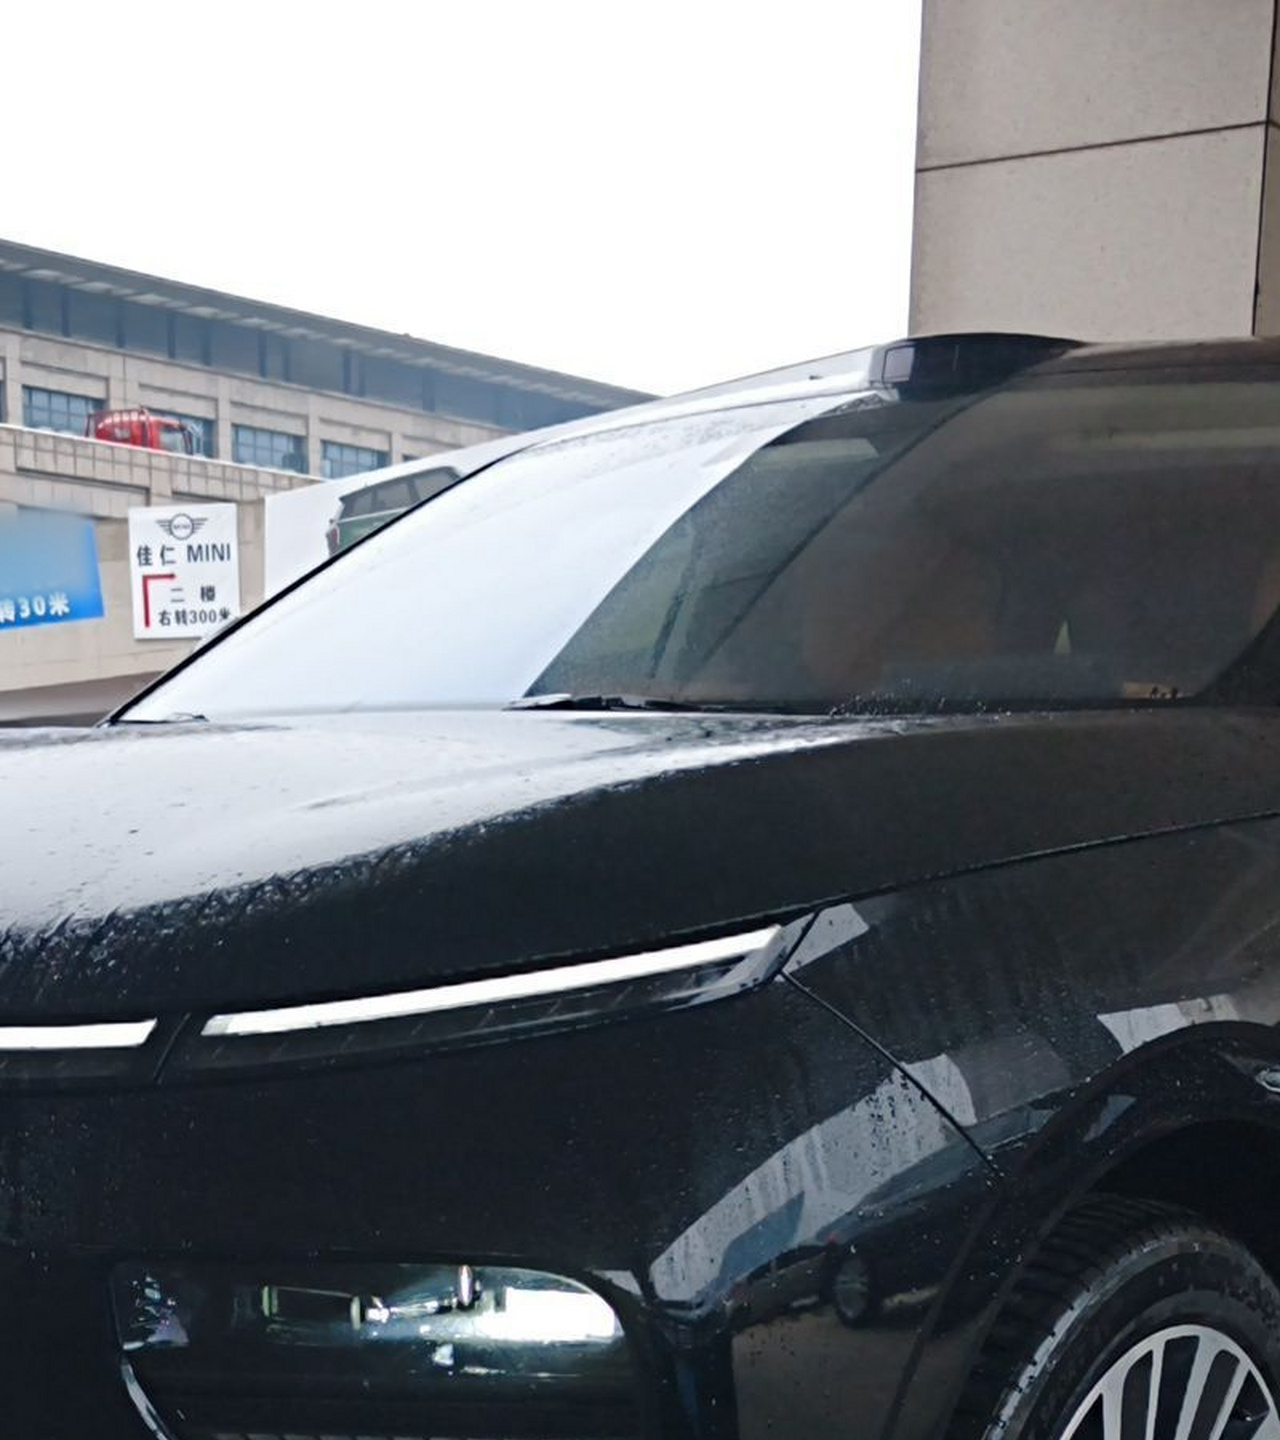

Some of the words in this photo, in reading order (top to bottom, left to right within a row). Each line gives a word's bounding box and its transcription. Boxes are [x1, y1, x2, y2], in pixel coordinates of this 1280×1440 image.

[137, 544, 176, 566] 佳仁
[187, 543, 231, 563] MINI
[171, 585, 216, 602] 二楼
[158, 606, 231, 627] 右转300米
